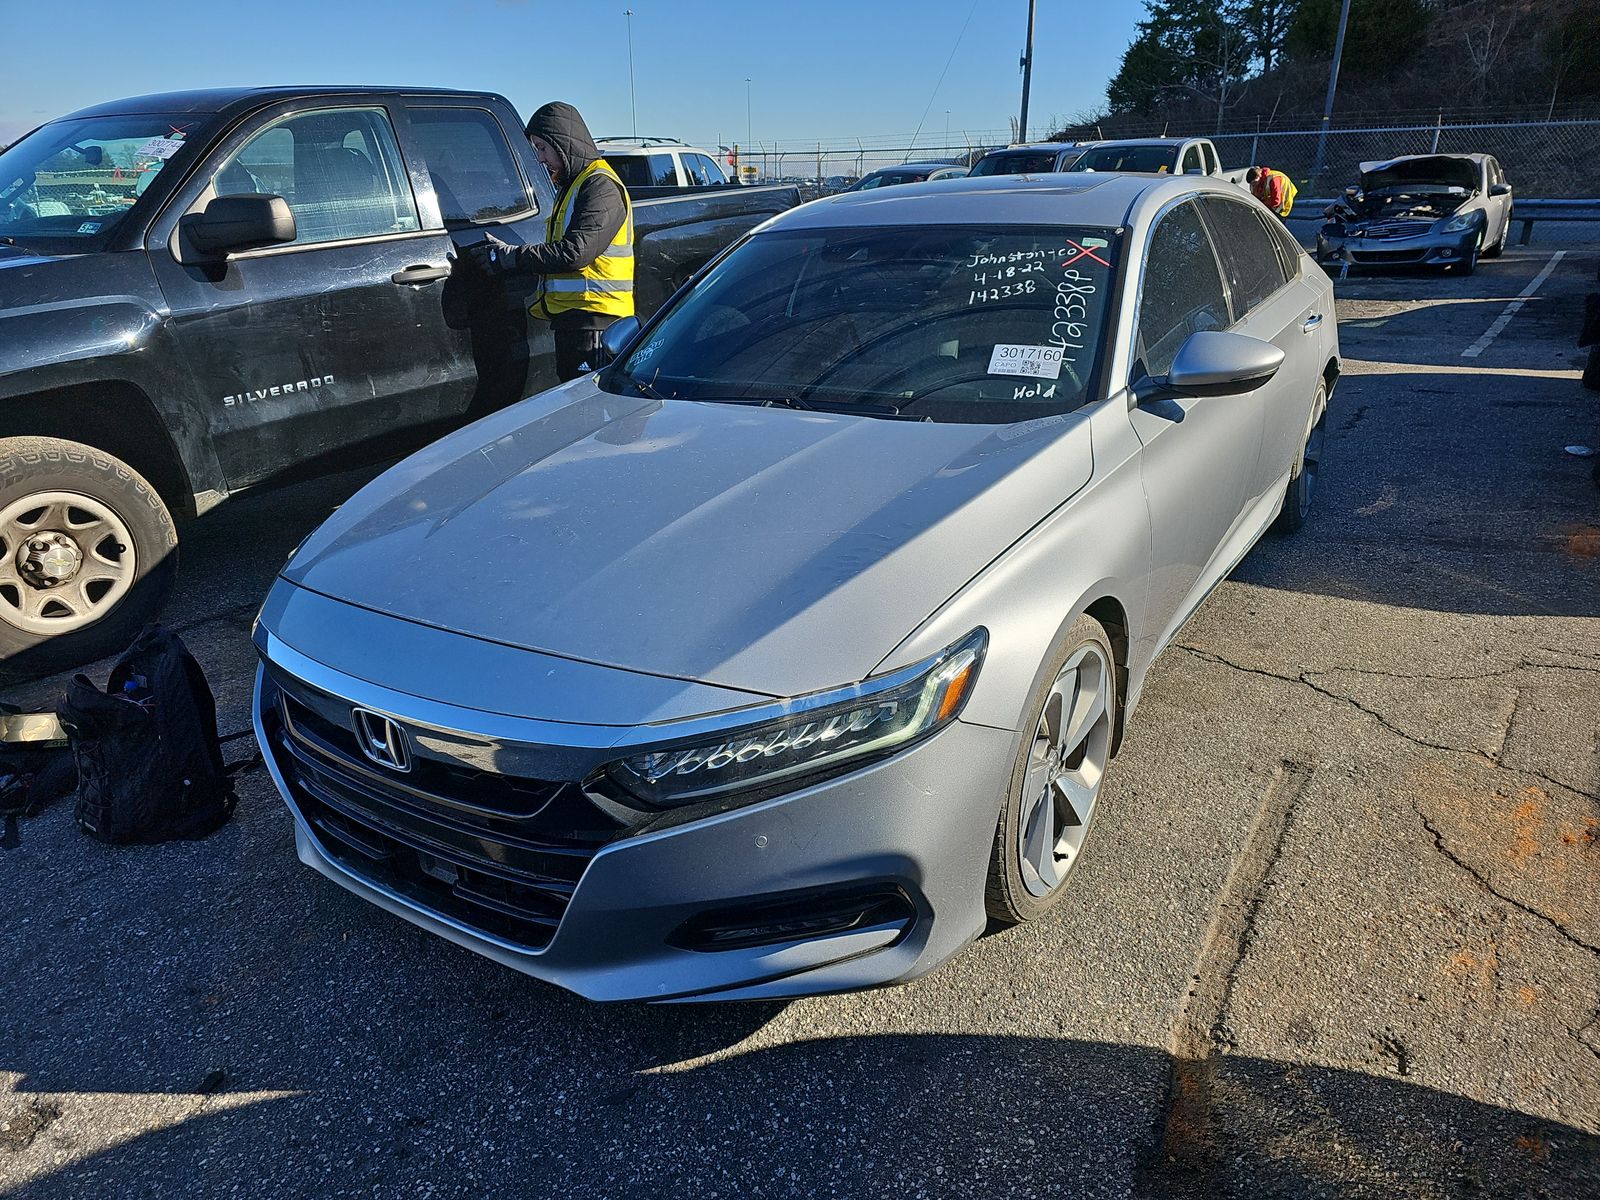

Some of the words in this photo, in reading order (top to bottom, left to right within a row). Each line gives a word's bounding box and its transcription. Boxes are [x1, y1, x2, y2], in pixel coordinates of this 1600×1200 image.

[974, 261, 1045, 285] 4-18-22
[969, 280, 1036, 305] 142338
[1000, 347, 1062, 362] 3017160
[223, 374, 335, 407] SILVERADO
[1013, 382, 1057, 400] Hold
